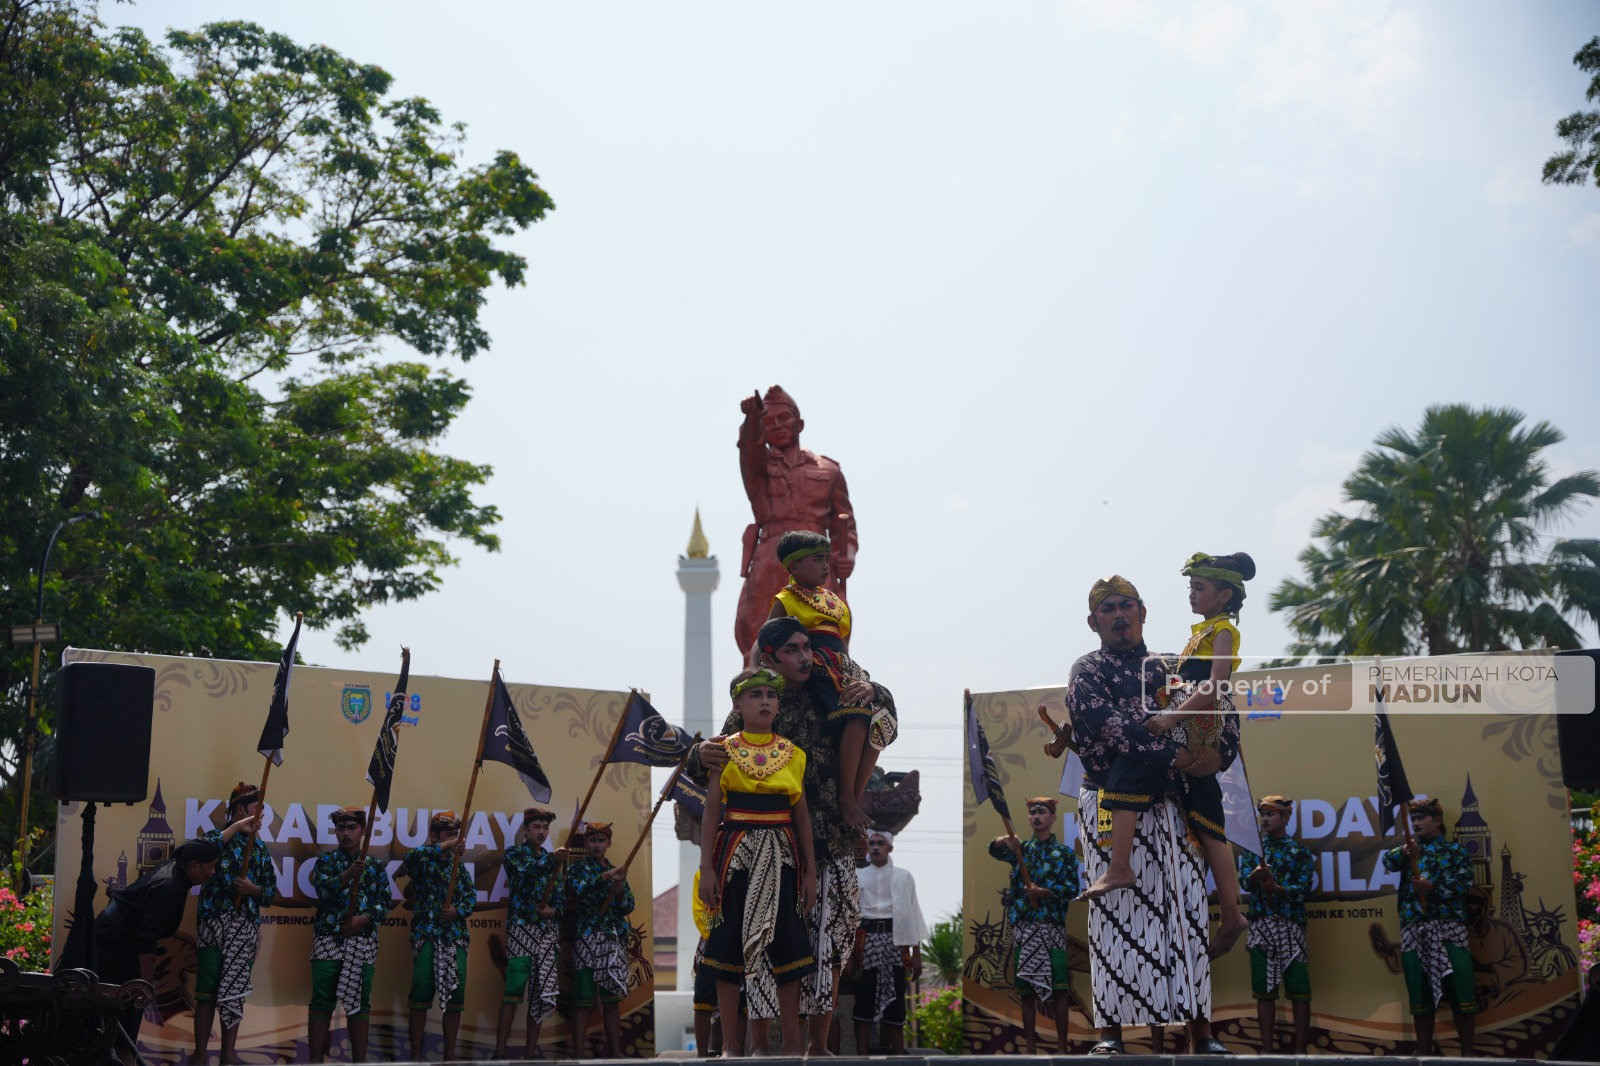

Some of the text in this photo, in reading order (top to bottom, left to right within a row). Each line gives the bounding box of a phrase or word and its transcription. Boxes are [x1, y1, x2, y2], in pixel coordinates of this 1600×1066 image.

[1330, 910, 1344, 919] KE
[1347, 908, 1383, 918] 108TH
[380, 918, 408, 927] KOTA
[470, 918, 501, 929] 108TH
